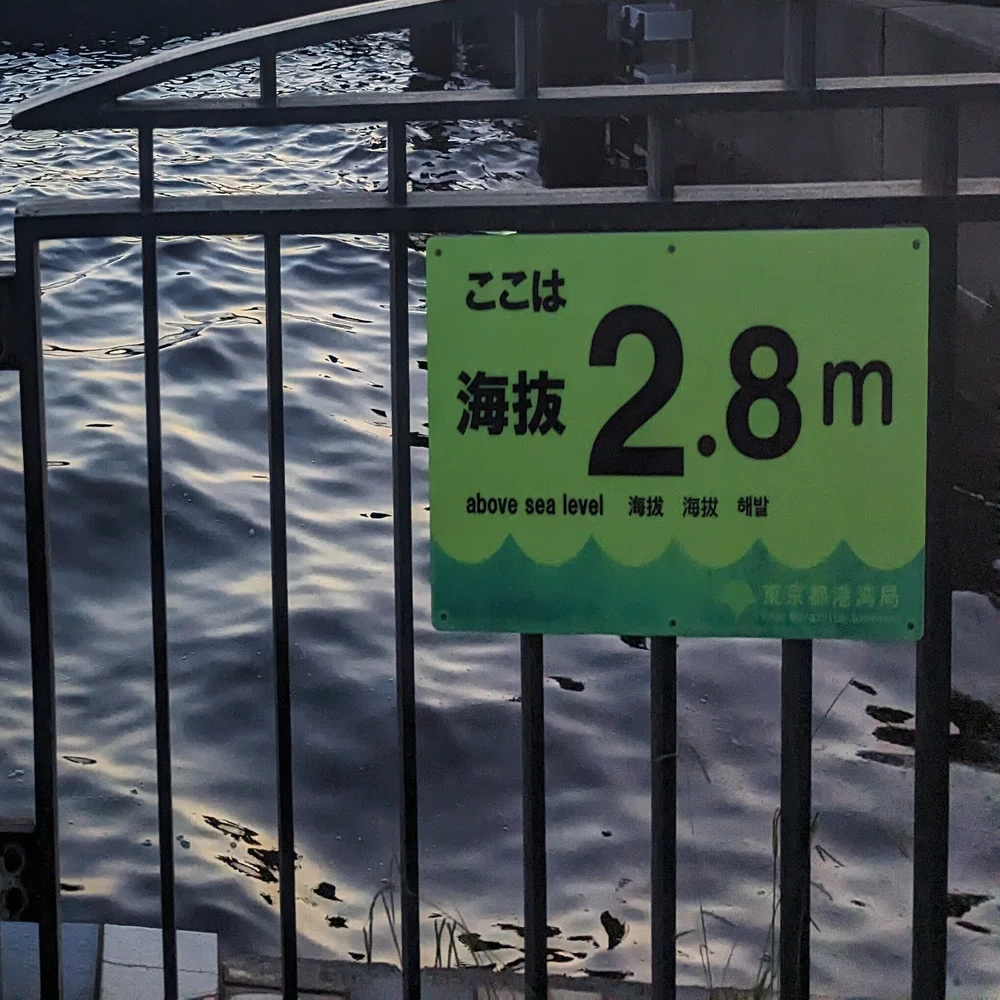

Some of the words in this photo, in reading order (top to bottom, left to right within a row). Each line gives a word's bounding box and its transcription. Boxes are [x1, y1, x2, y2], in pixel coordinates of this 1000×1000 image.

[465, 268, 568, 313] ここは
[455, 370, 568, 437] 海抜
[465, 492, 519, 516] above
[525, 497, 557, 517] sea
[562, 493, 605, 518] level
[736, 495, 770, 518] 해발
